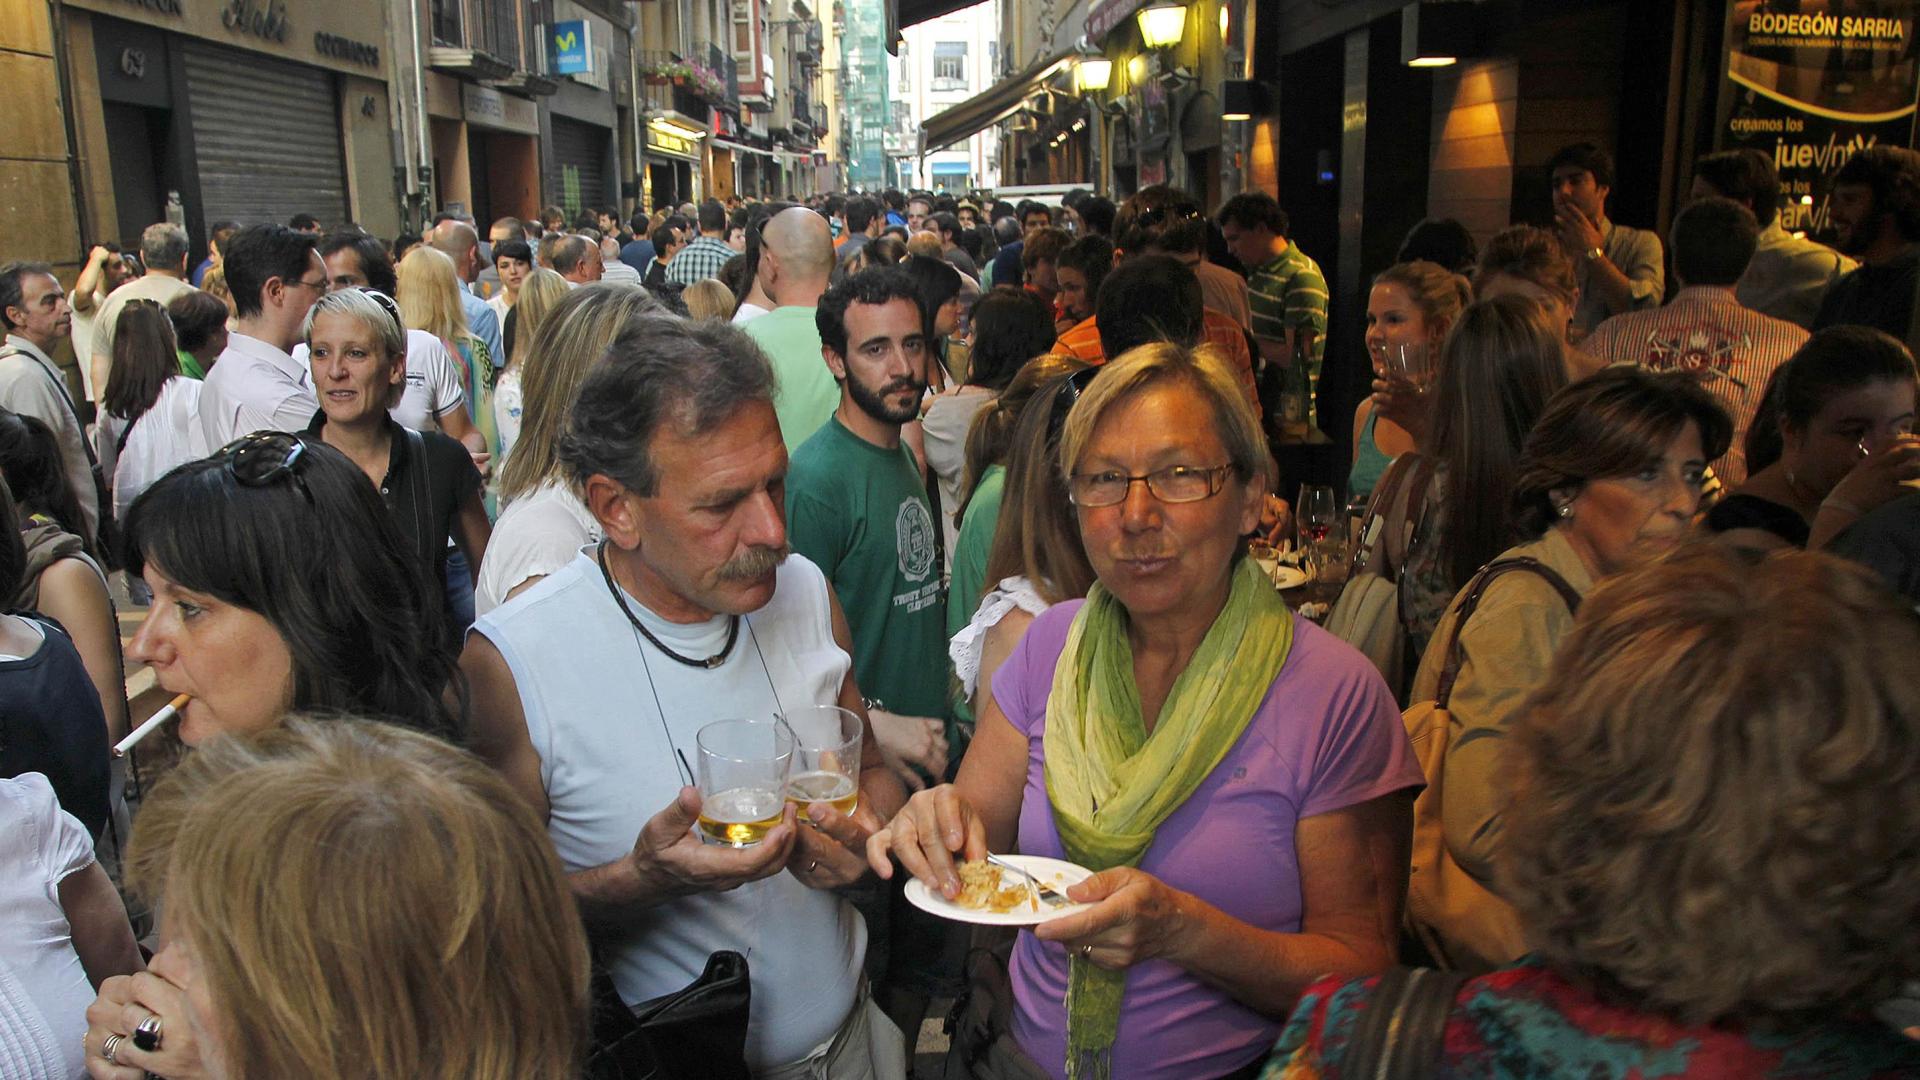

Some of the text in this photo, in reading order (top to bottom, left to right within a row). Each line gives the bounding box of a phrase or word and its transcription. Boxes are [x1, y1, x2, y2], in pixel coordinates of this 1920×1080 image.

[1750, 10, 1904, 39] BODEGÓN SARRIA
[1730, 116, 1804, 133] creamos los
[1793, 178, 1811, 194] los
